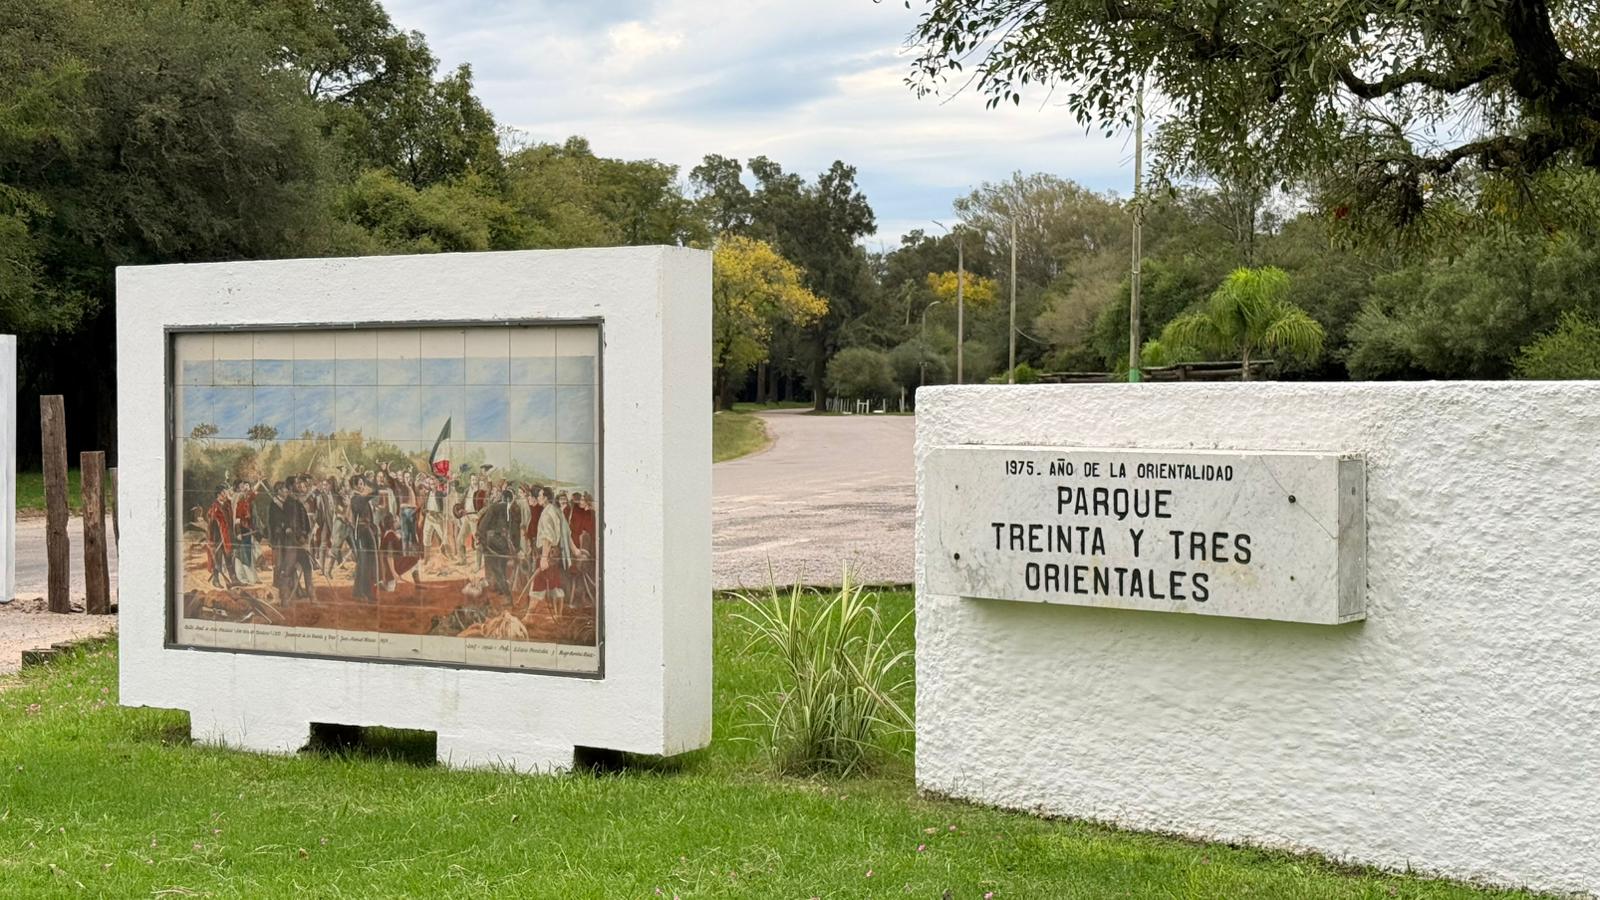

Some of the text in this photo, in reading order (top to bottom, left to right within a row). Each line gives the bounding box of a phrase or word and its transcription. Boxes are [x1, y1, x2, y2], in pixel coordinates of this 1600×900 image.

[1049, 458, 1074, 477] AÑO
[1084, 462, 1101, 478] DE
[1110, 462, 1127, 478] LA
[1137, 463, 1233, 482] ORIENTALIDAD
[1057, 485, 1172, 520] PARQUE
[991, 522, 1252, 565] TREINTA Y TRES
[1025, 562, 1209, 603] ORIENTALES
